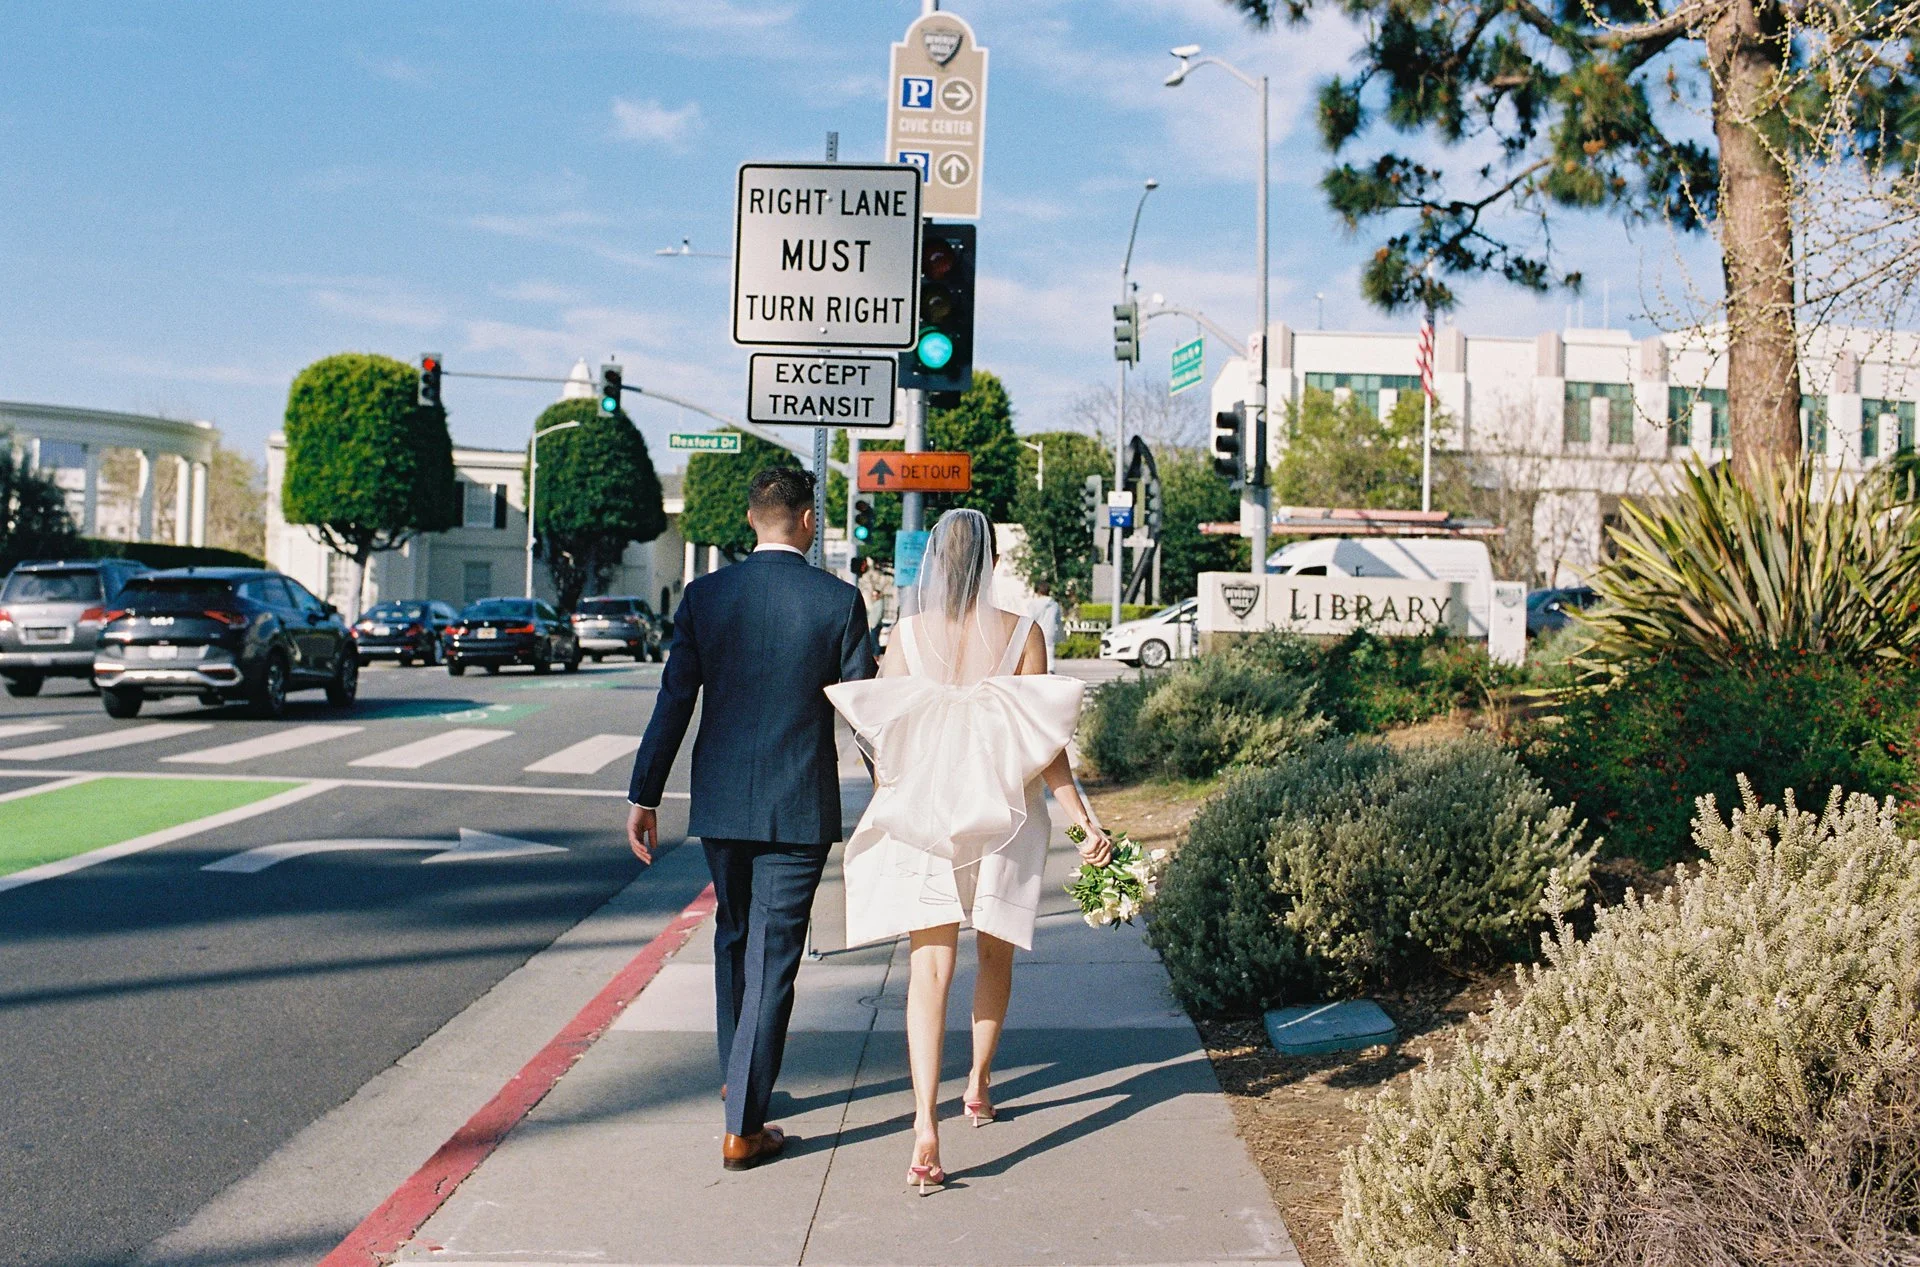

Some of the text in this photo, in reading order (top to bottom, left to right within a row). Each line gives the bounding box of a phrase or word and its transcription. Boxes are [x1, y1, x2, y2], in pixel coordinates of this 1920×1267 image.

[907, 79, 930, 107] P
[899, 117, 973, 136] CIVIC CENTER
[750, 188, 908, 217] RIGHT LANE
[782, 239, 872, 273] MUST
[746, 295, 906, 324] TURN RIGHT
[776, 363, 872, 386] EXCEPT
[769, 394, 875, 418] TRANSIT
[671, 435, 736, 449] Rexford Dr
[900, 464, 962, 480] DETOUR
[1289, 587, 1452, 624] LIBRARY
